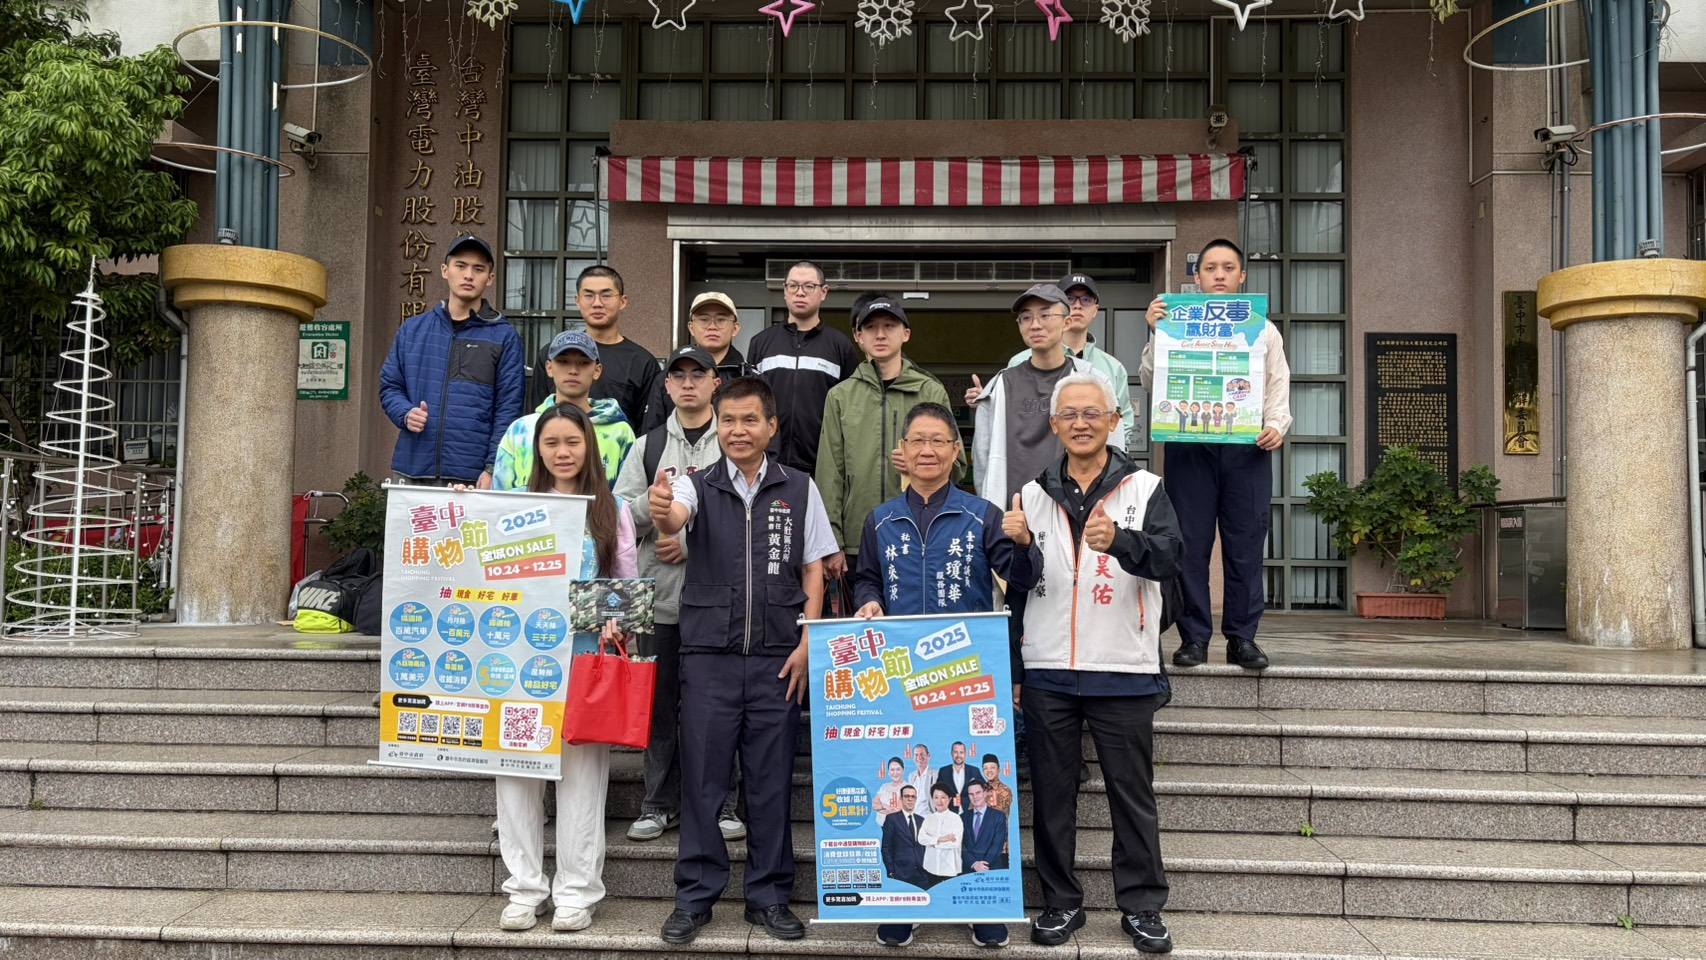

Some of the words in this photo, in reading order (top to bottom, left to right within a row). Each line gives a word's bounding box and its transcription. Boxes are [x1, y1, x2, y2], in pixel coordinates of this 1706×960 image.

[453, 56, 487, 237] 台灣中油股
[1172, 301, 1250, 321] 企業反毒
[1186, 322, 1233, 337] 贏財富
[411, 502, 464, 532] 臺中
[502, 509, 547, 531] 2025
[1124, 505, 1136, 529] 台中
[402, 521, 488, 568] 購物節
[527, 539, 554, 553] SALE
[768, 533, 781, 574] 黃金龍
[901, 532, 911, 555] 秘書
[487, 565, 520, 576] 10.24
[533, 560, 562, 571] 12.25
[946, 538, 963, 603] 吳瓊華
[298, 586, 341, 611] NIKE
[440, 587, 452, 598] 抽
[829, 629, 885, 666] 臺中
[920, 627, 966, 655] 2025
[825, 648, 912, 700] 購物節
[950, 660, 979, 677] SALE
[913, 691, 947, 706] 10.24
[959, 682, 991, 698] 12.25
[825, 727, 838, 739] 抽
[843, 727, 861, 737] 現金
[867, 726, 887, 737] 好宅
[892, 726, 910, 736] 好車
[823, 794, 838, 817] 5
